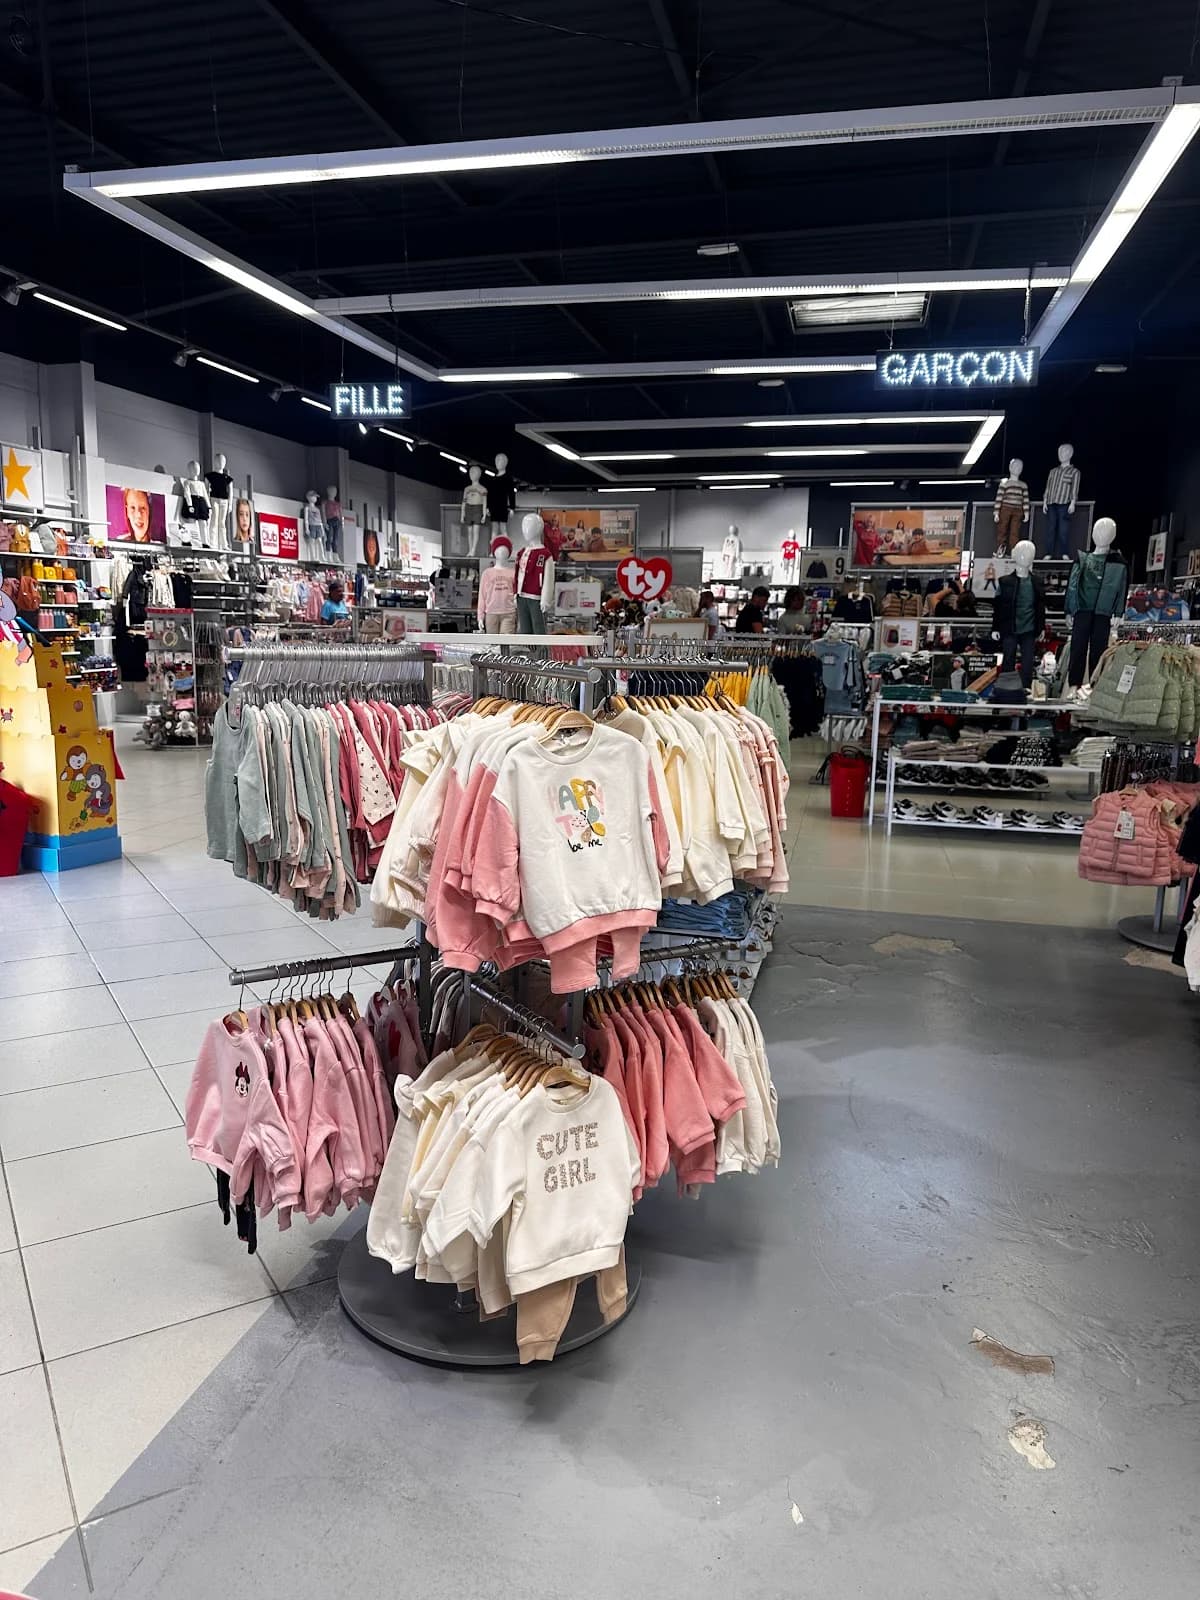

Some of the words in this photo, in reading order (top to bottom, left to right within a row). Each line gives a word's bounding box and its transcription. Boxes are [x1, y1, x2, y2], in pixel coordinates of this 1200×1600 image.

[881, 349, 1034, 387] GARÇON
[335, 384, 403, 416] FILLE
[621, 560, 666, 599] ty
[835, 556, 845, 575] 9
[567, 839, 584, 853] be
[588, 838, 603, 848] me
[536, 1121, 599, 1160] CUTE
[543, 1157, 597, 1193] GIRL
